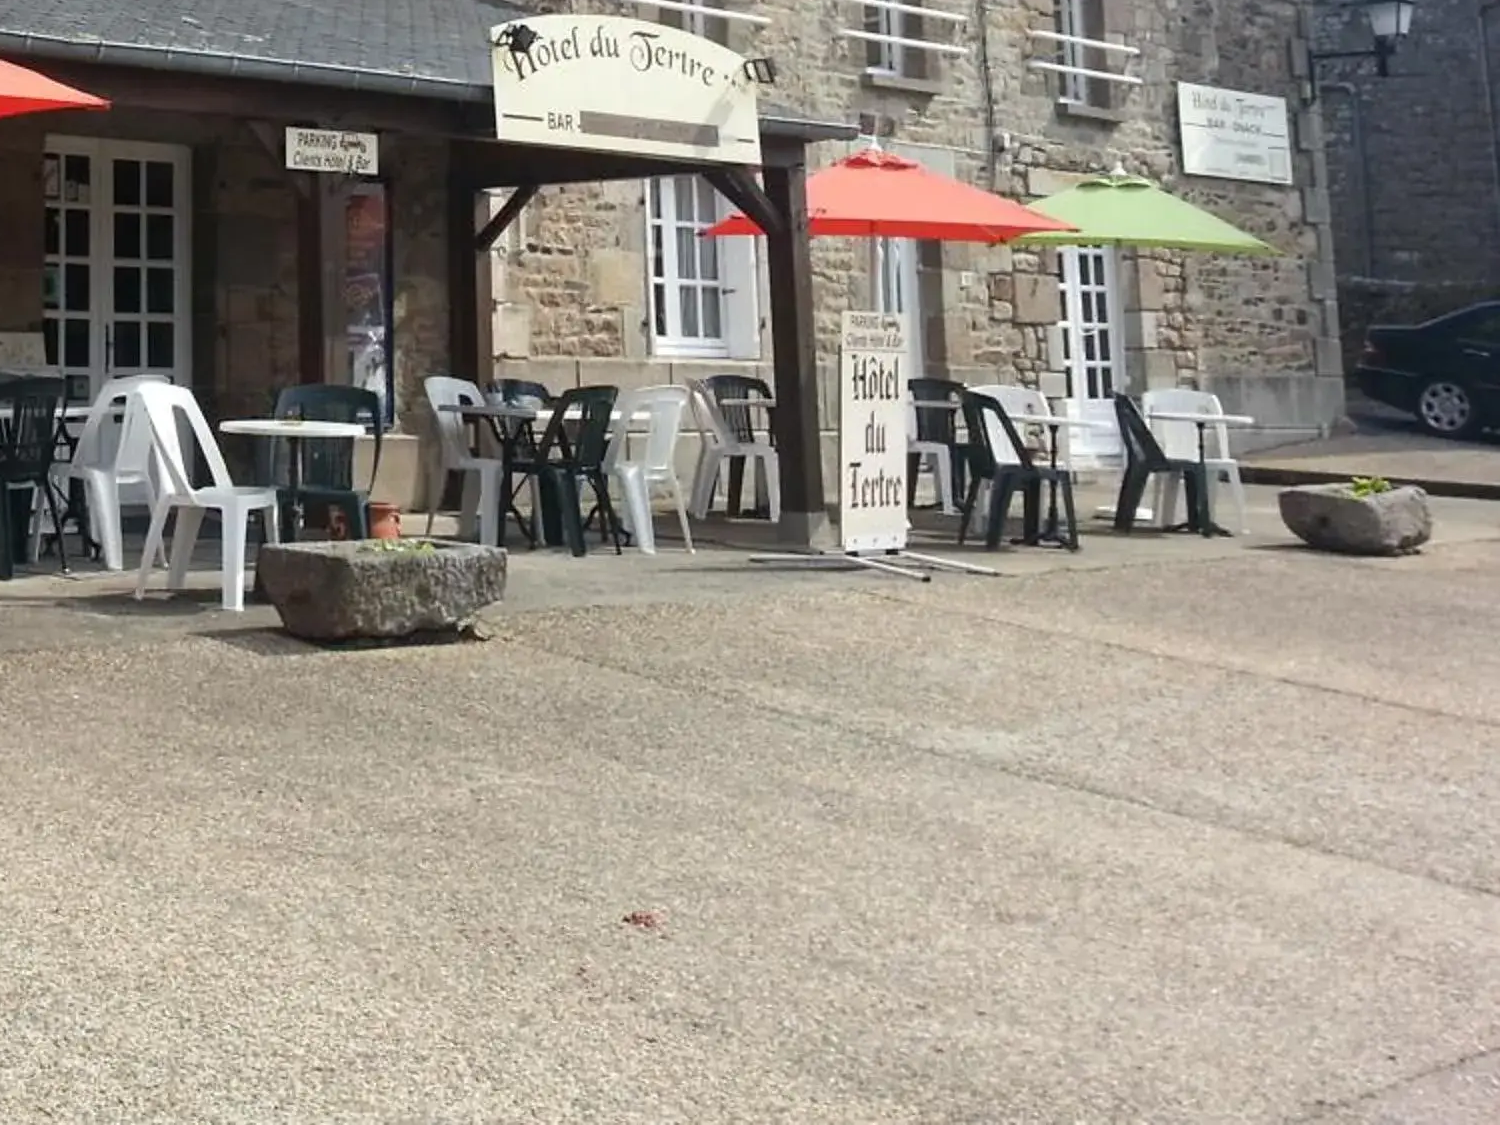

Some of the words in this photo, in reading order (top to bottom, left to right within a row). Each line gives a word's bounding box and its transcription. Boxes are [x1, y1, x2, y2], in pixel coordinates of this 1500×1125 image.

[590, 25, 620, 58] du
[630, 32, 714, 86] Tertre
[297, 132, 338, 150] PARKING
[547, 112, 574, 131] BAR
[851, 354, 900, 400] Hôtel
[865, 410, 887, 454] du
[849, 462, 902, 508] Tertre
